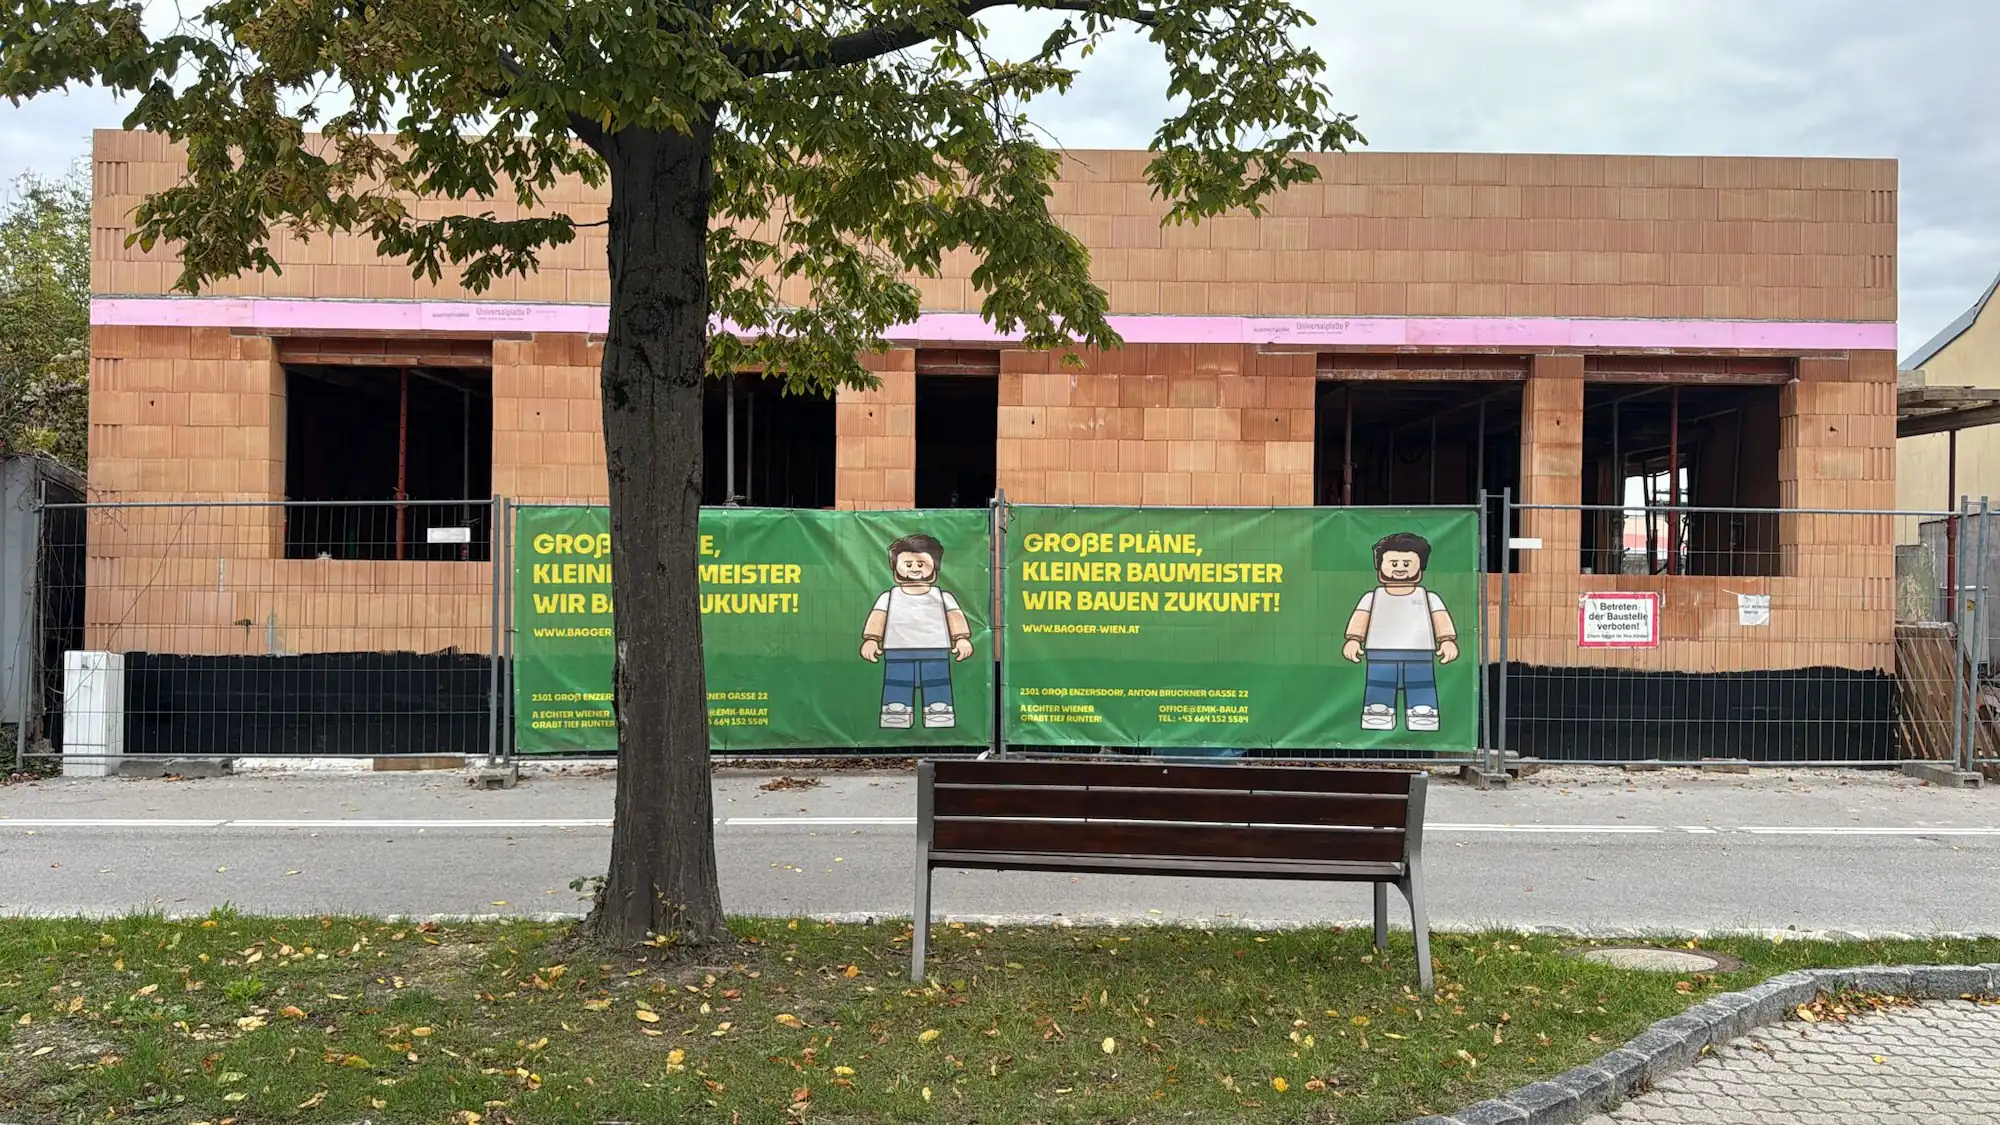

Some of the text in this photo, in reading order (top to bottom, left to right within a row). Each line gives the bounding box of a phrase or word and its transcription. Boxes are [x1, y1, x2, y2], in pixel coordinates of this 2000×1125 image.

[533, 533, 611, 559] GROß
[1023, 530, 1204, 558] GROßE PLÄNE,
[533, 563, 802, 585] KLEIN MEISTER
[1022, 561, 1284, 584] KLEINER BAUMEISTER
[533, 593, 587, 614] WIR
[699, 593, 799, 614] UKUNFT!
[1022, 590, 1281, 613] WIR BAUEN ZUKUNFT!
[1600, 602, 1638, 611] Betreten
[1588, 612, 1648, 621] der Baustelle
[1022, 623, 1140, 634] WWW.BAGGER-WIEN.AT
[1597, 622, 1640, 631] verboten!
[533, 627, 615, 638] WWW.BAGGER-
[532, 692, 553, 702] 2301
[554, 692, 582, 702] GROß
[727, 692, 756, 700] GASSE
[757, 692, 768, 700] 22
[1020, 687, 1249, 698] 2301 GROß ENZERSDORF, ANTON BRUCKNER GASSE 22
[708, 708, 768, 717] @EMK-BAU.AT
[1020, 704, 1095, 713] A ECHTER WIENER
[1158, 705, 1249, 714] OFFICE@EMK-BAU.AT
[532, 710, 610, 719] A ECHTER WIENER
[1020, 714, 1103, 723] GRABT TIEF RUNTER!
[1194, 714, 1211, 723] 664
[1211, 715, 1227, 723] 152
[1227, 715, 1249, 724] 5584
[531, 720, 562, 729] GRABT
[563, 720, 580, 729] TIEF
[713, 718, 731, 726] 664
[731, 717, 747, 726] 152
[747, 717, 768, 725] 5584
